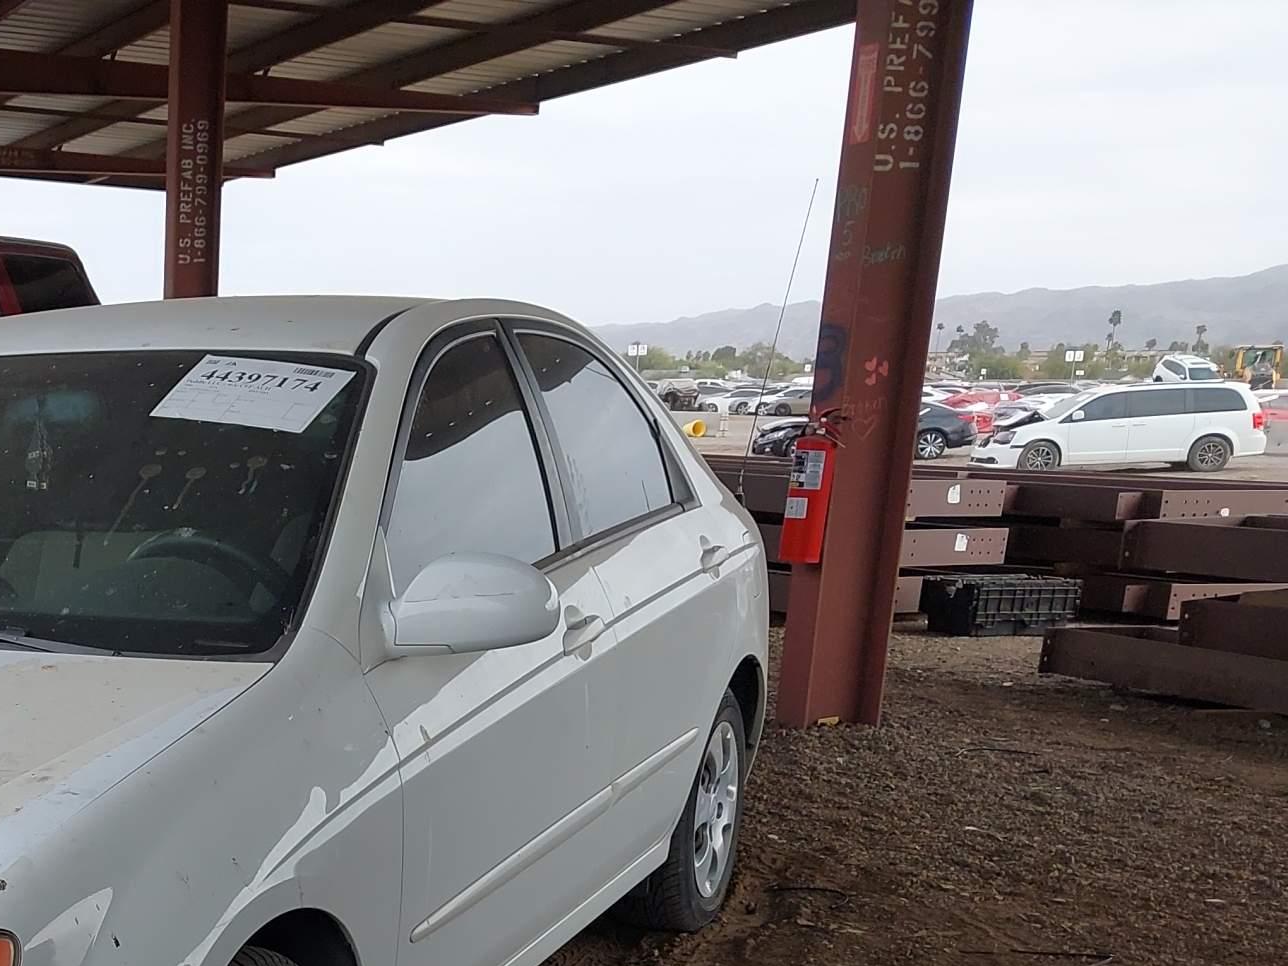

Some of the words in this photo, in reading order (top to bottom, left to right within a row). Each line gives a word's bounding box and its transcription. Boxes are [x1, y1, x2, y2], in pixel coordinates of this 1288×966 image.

[182, 118, 196, 150] INC.
[873, 113, 900, 172] U.S.
[179, 159, 194, 223] PREFAB
[178, 233, 192, 265] U.S.
[200, 369, 322, 392] 44397174
